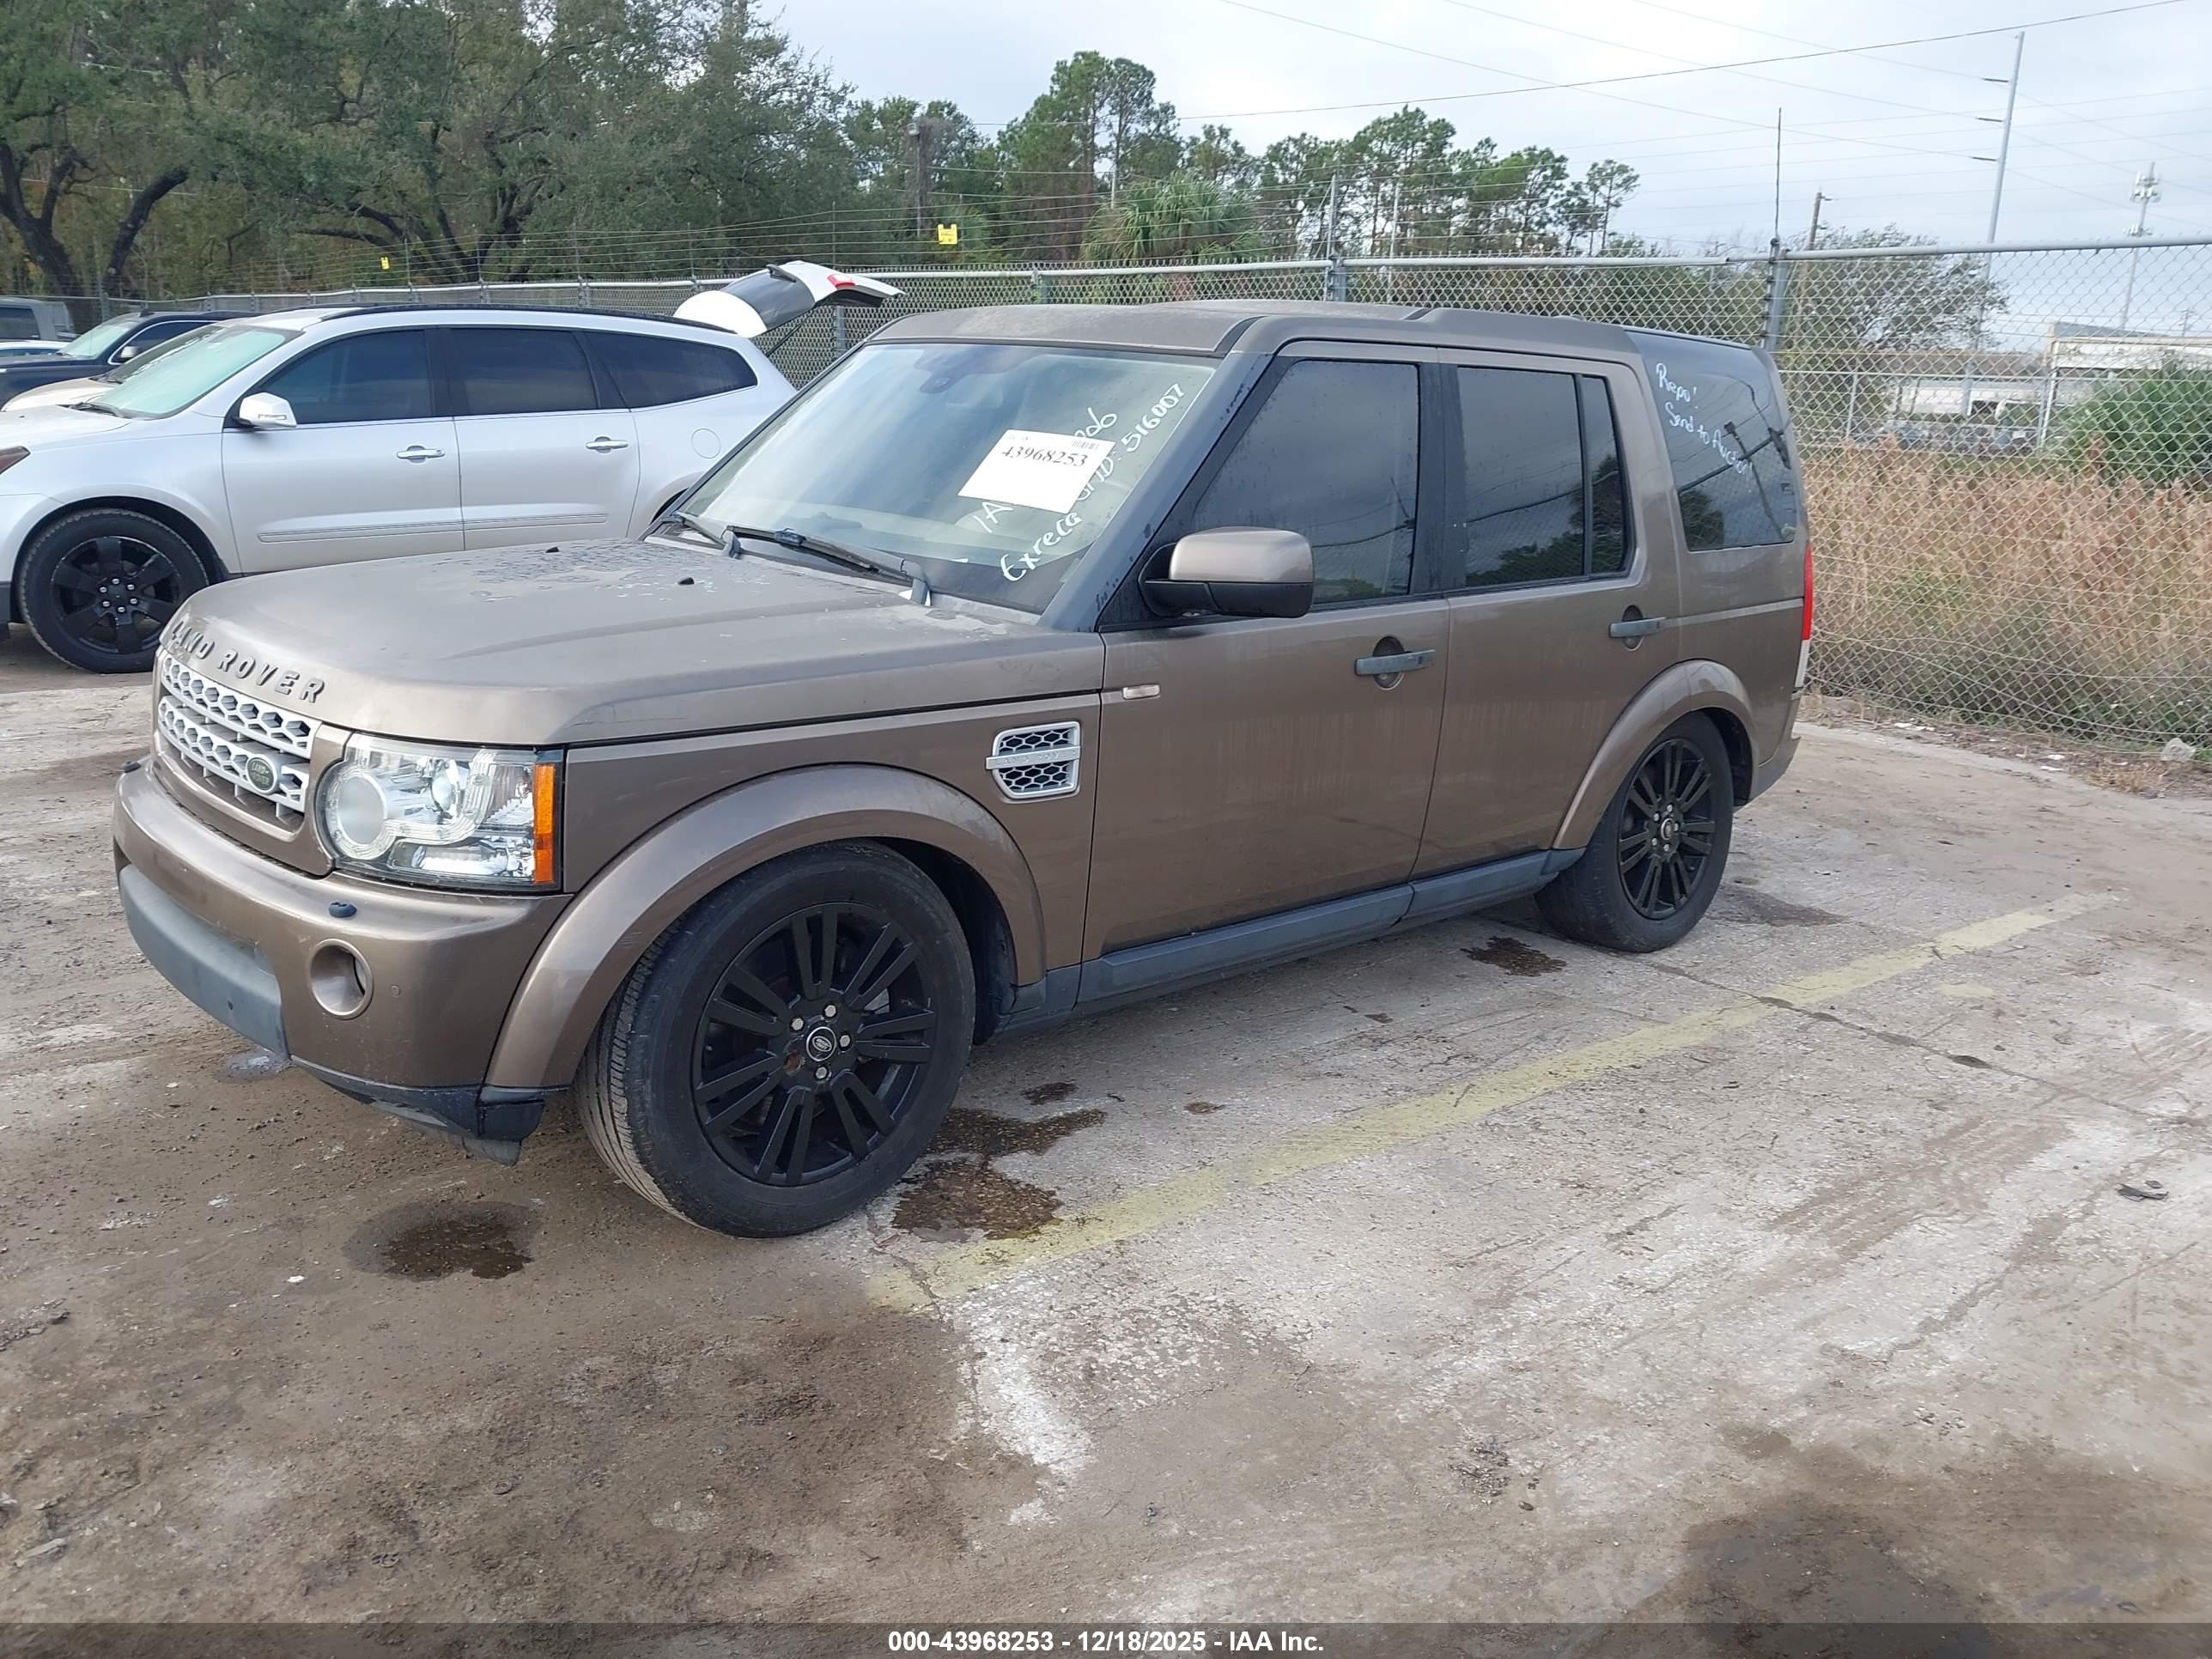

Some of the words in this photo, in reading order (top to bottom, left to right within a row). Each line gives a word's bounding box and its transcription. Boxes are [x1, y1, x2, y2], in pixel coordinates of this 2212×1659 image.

[1655, 362, 1699, 409] Repo!
[1120, 383, 1185, 453] 516007
[1664, 401, 1694, 433] Send
[1696, 424, 1711, 445] to
[1001, 445, 1089, 467] 43968253
[217, 647, 325, 704] ROVER
